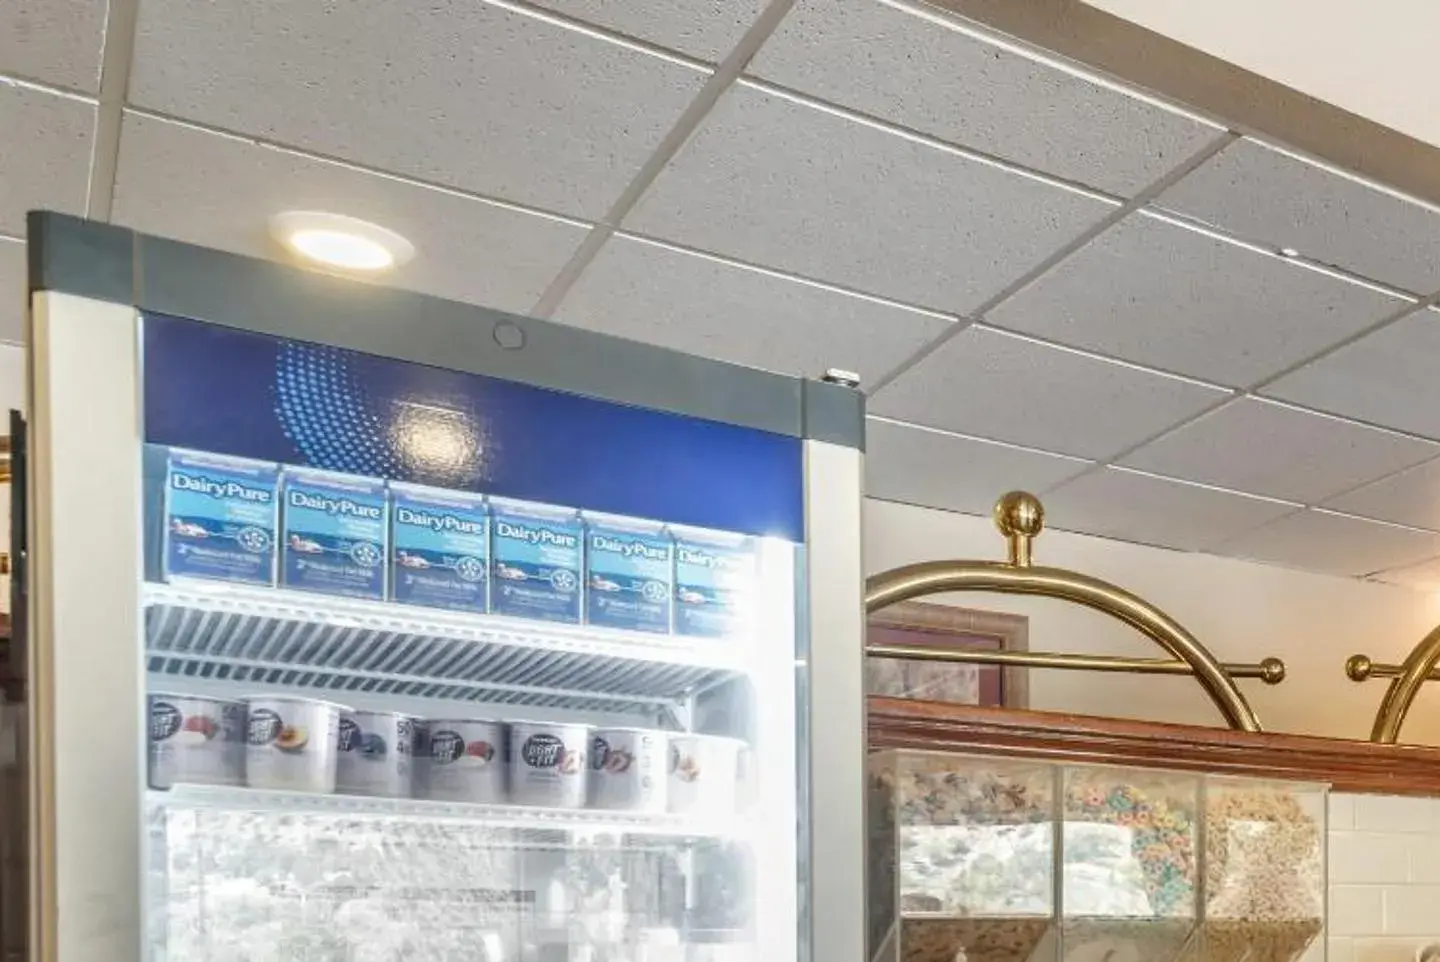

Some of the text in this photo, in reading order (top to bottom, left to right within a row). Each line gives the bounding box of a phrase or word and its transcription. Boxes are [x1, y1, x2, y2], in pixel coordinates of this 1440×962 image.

[173, 472, 271, 501] DairyPure
[290, 491, 381, 519] DairyPure
[398, 509, 483, 535] DairyPure
[498, 522, 577, 547] DairyPure
[594, 536, 667, 560] DairyPure
[678, 549, 727, 569] Dairy
